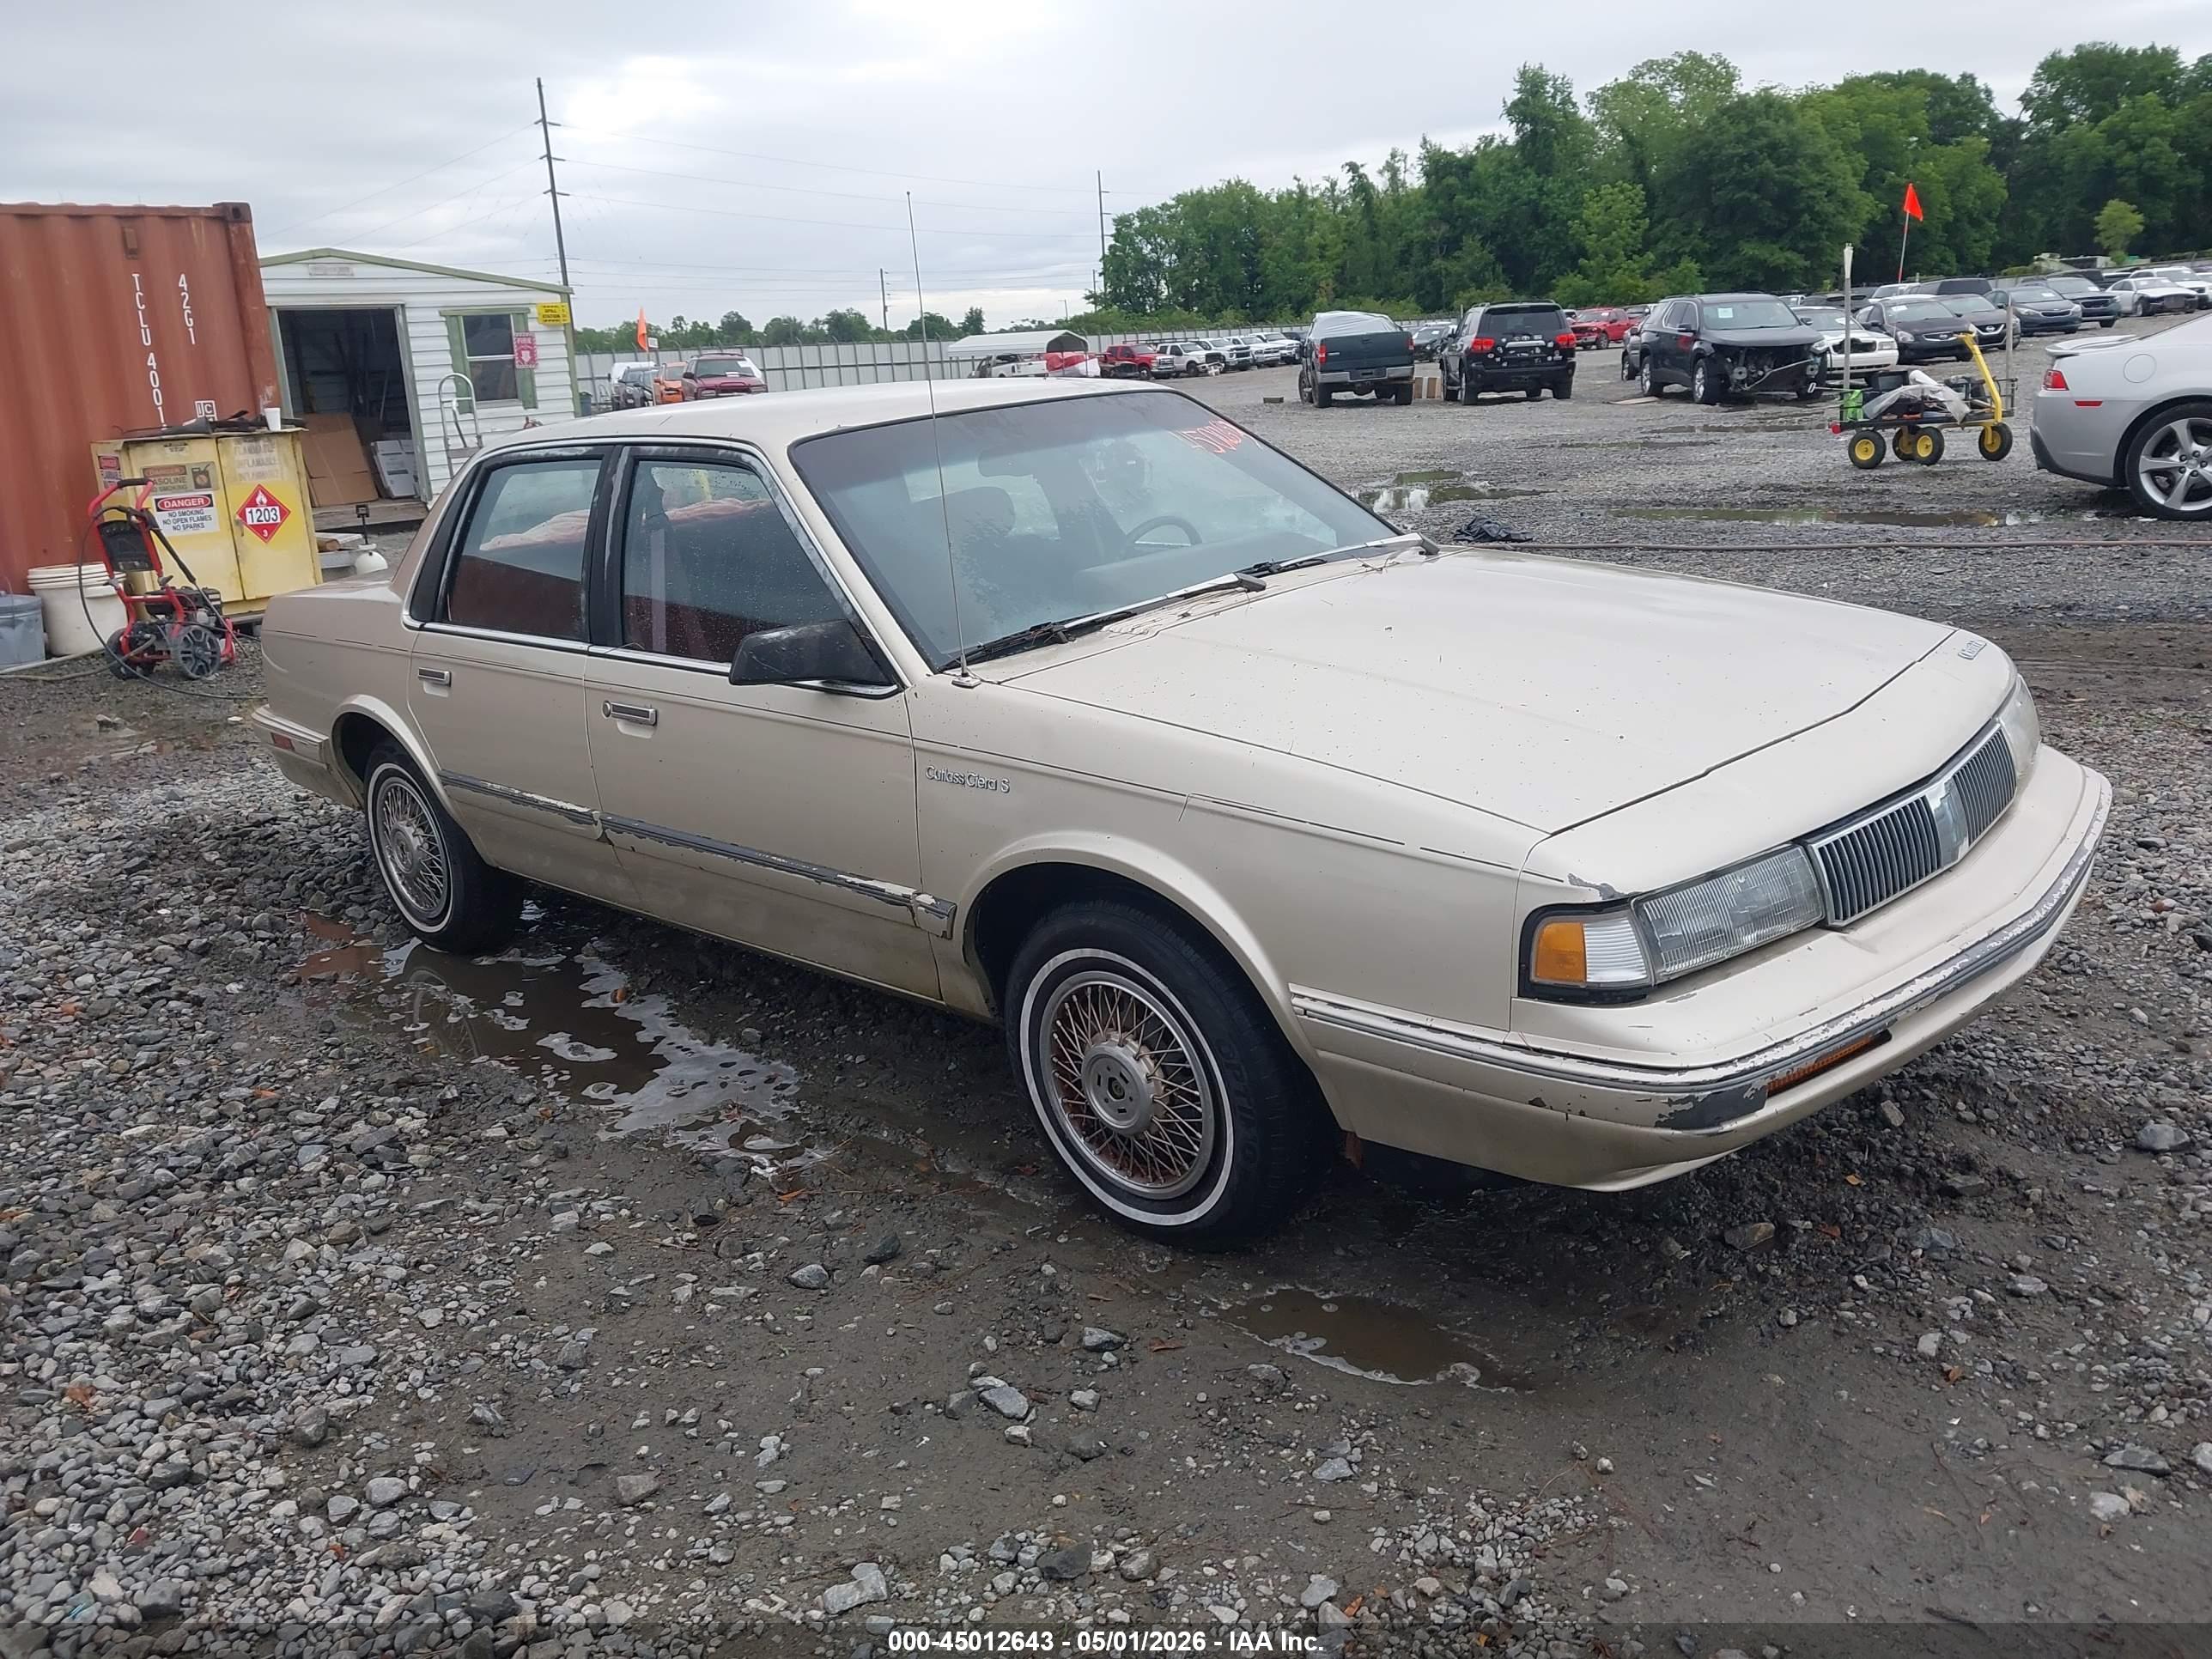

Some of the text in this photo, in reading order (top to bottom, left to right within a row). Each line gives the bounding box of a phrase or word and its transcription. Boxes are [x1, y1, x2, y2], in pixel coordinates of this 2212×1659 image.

[179, 273, 195, 344] 42G1
[131, 273, 167, 430] TCLU 4001
[153, 476, 187, 485] ASOLINE
[163, 497, 205, 508] DANGER
[178, 508, 204, 517] SMOKING
[248, 507, 278, 523] 1203
[926, 765, 1011, 793] Cutlass Ciera S
